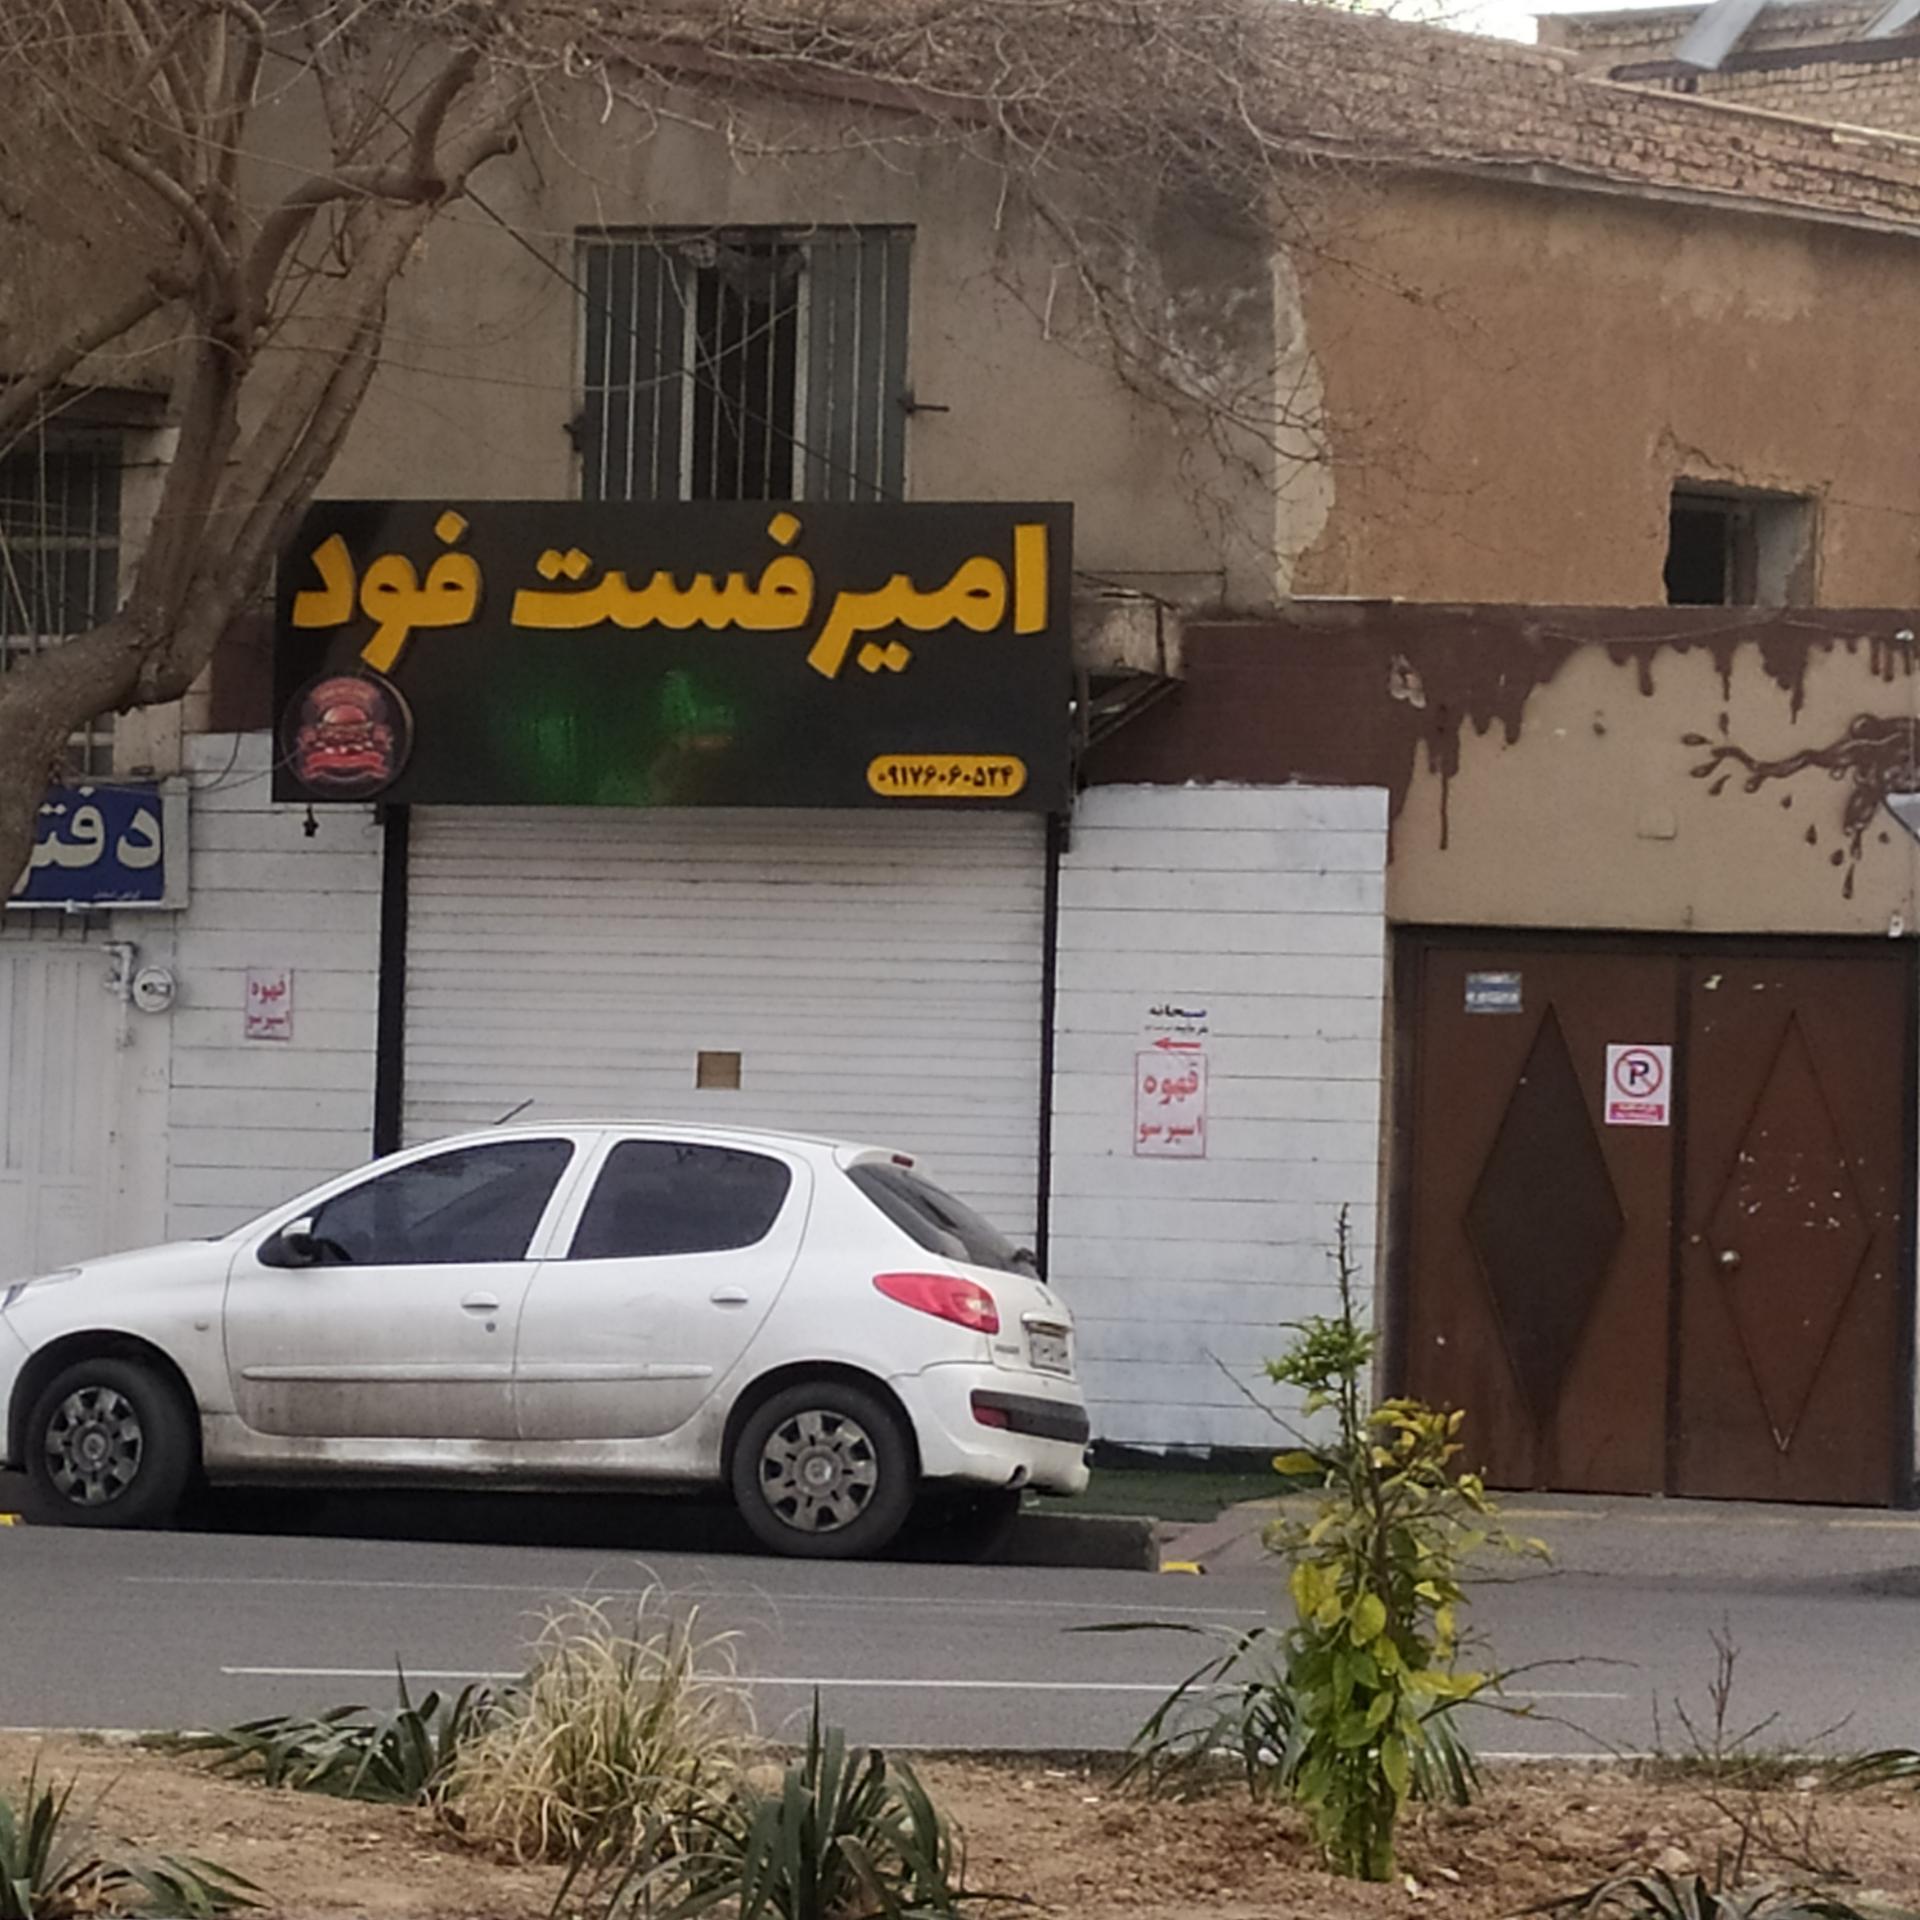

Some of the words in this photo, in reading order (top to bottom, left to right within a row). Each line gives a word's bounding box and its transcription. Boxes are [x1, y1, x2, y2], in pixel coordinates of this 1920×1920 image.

[293, 512, 479, 673] فود
[511, 513, 814, 631] فست
[11, 786, 161, 895] دفتر
[1143, 1062, 1199, 1105] قهوه
[1628, 1060, 1650, 1086] P
